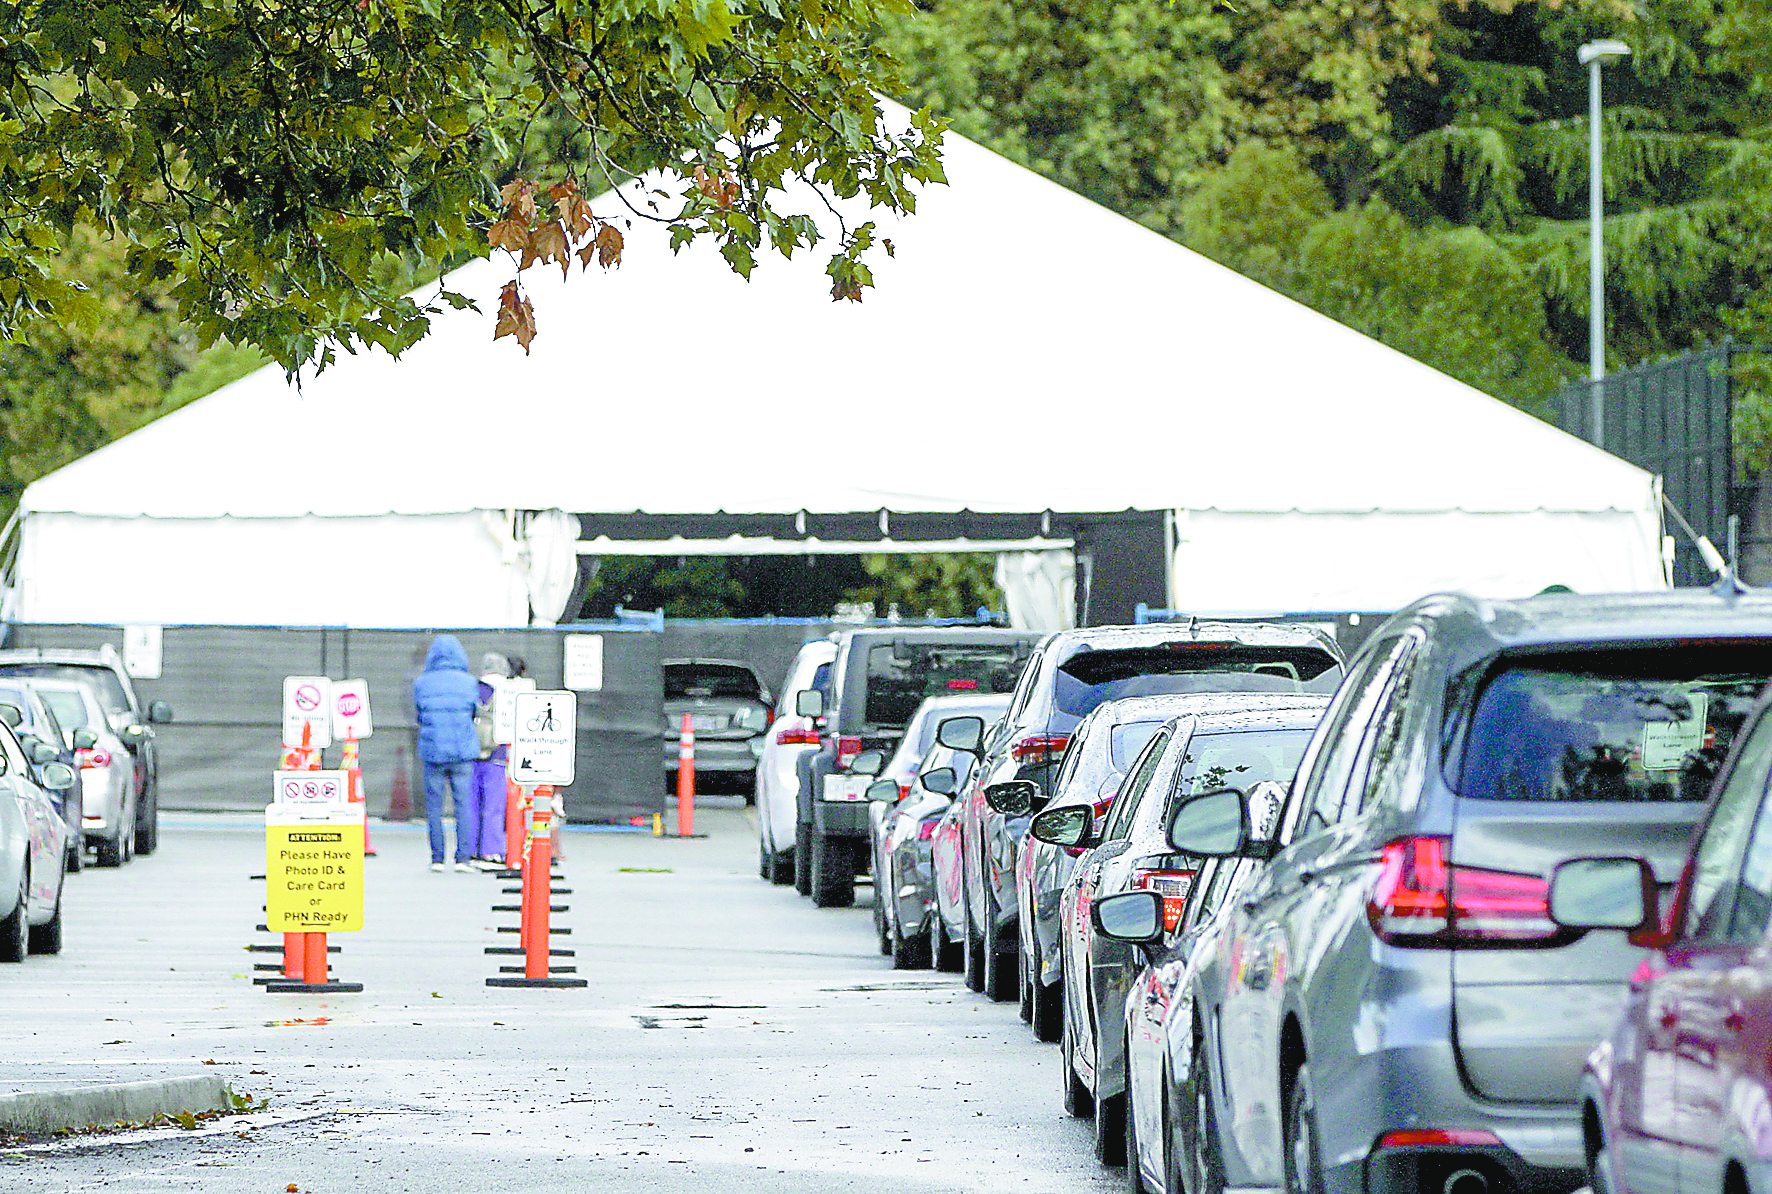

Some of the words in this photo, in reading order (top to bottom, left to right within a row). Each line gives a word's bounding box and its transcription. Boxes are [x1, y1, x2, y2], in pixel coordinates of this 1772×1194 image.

[280, 850, 319, 859] Please
[323, 850, 351, 859] Have
[285, 865, 318, 875] Photo
[322, 865, 334, 875] ID
[337, 865, 346, 875] &
[287, 880, 314, 890] Care
[318, 880, 345, 890] Card
[309, 898, 323, 906] or
[284, 912, 308, 921] PHN
[313, 912, 348, 923] Ready
